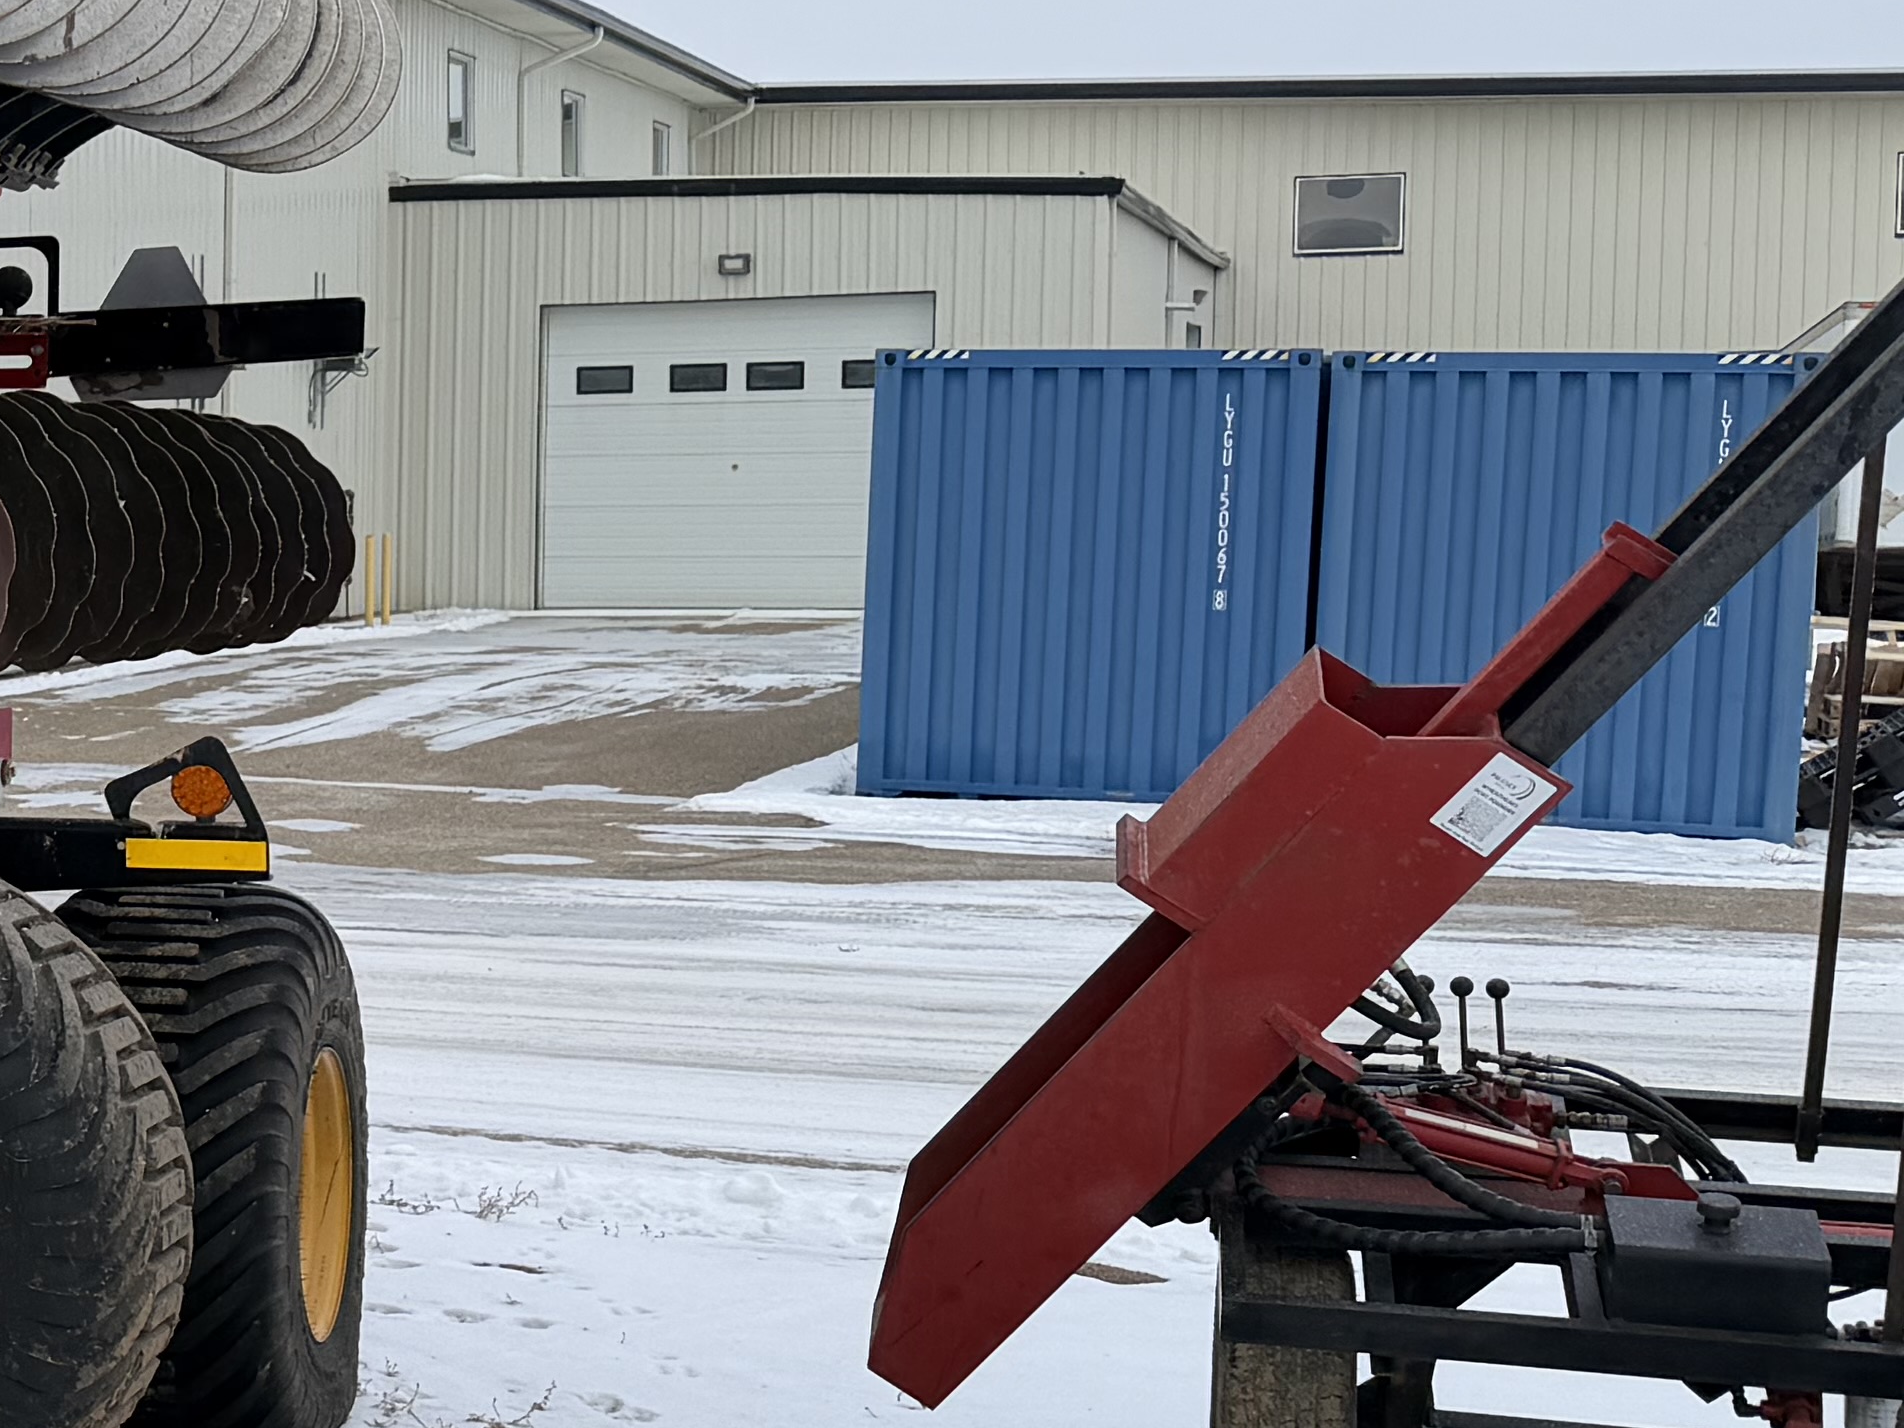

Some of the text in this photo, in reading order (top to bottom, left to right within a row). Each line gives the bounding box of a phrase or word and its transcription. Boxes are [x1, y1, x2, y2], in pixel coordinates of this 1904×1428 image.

[1222, 393, 1235, 467] LYGU
[1718, 399, 1733, 465] LYG
[1216, 473, 1230, 584] 150067
